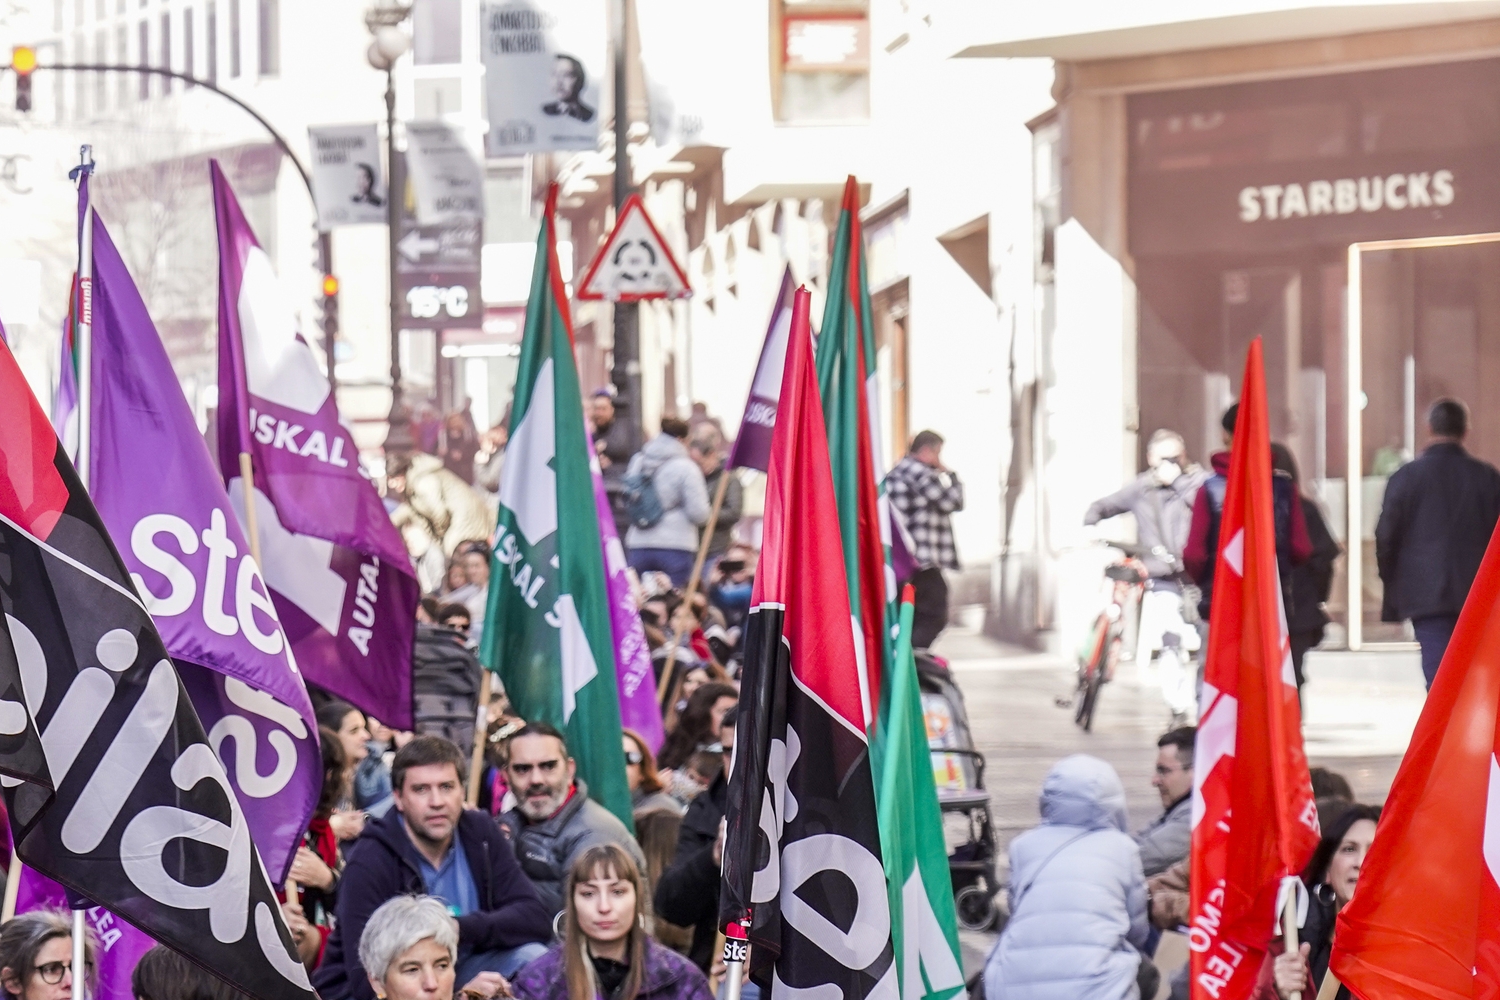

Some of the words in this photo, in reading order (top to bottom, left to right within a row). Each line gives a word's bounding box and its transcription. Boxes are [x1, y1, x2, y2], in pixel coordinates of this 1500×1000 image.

[1239, 169, 1455, 223] STARBUCKS
[130, 507, 285, 656] ste
[723, 940, 747, 961] ste
